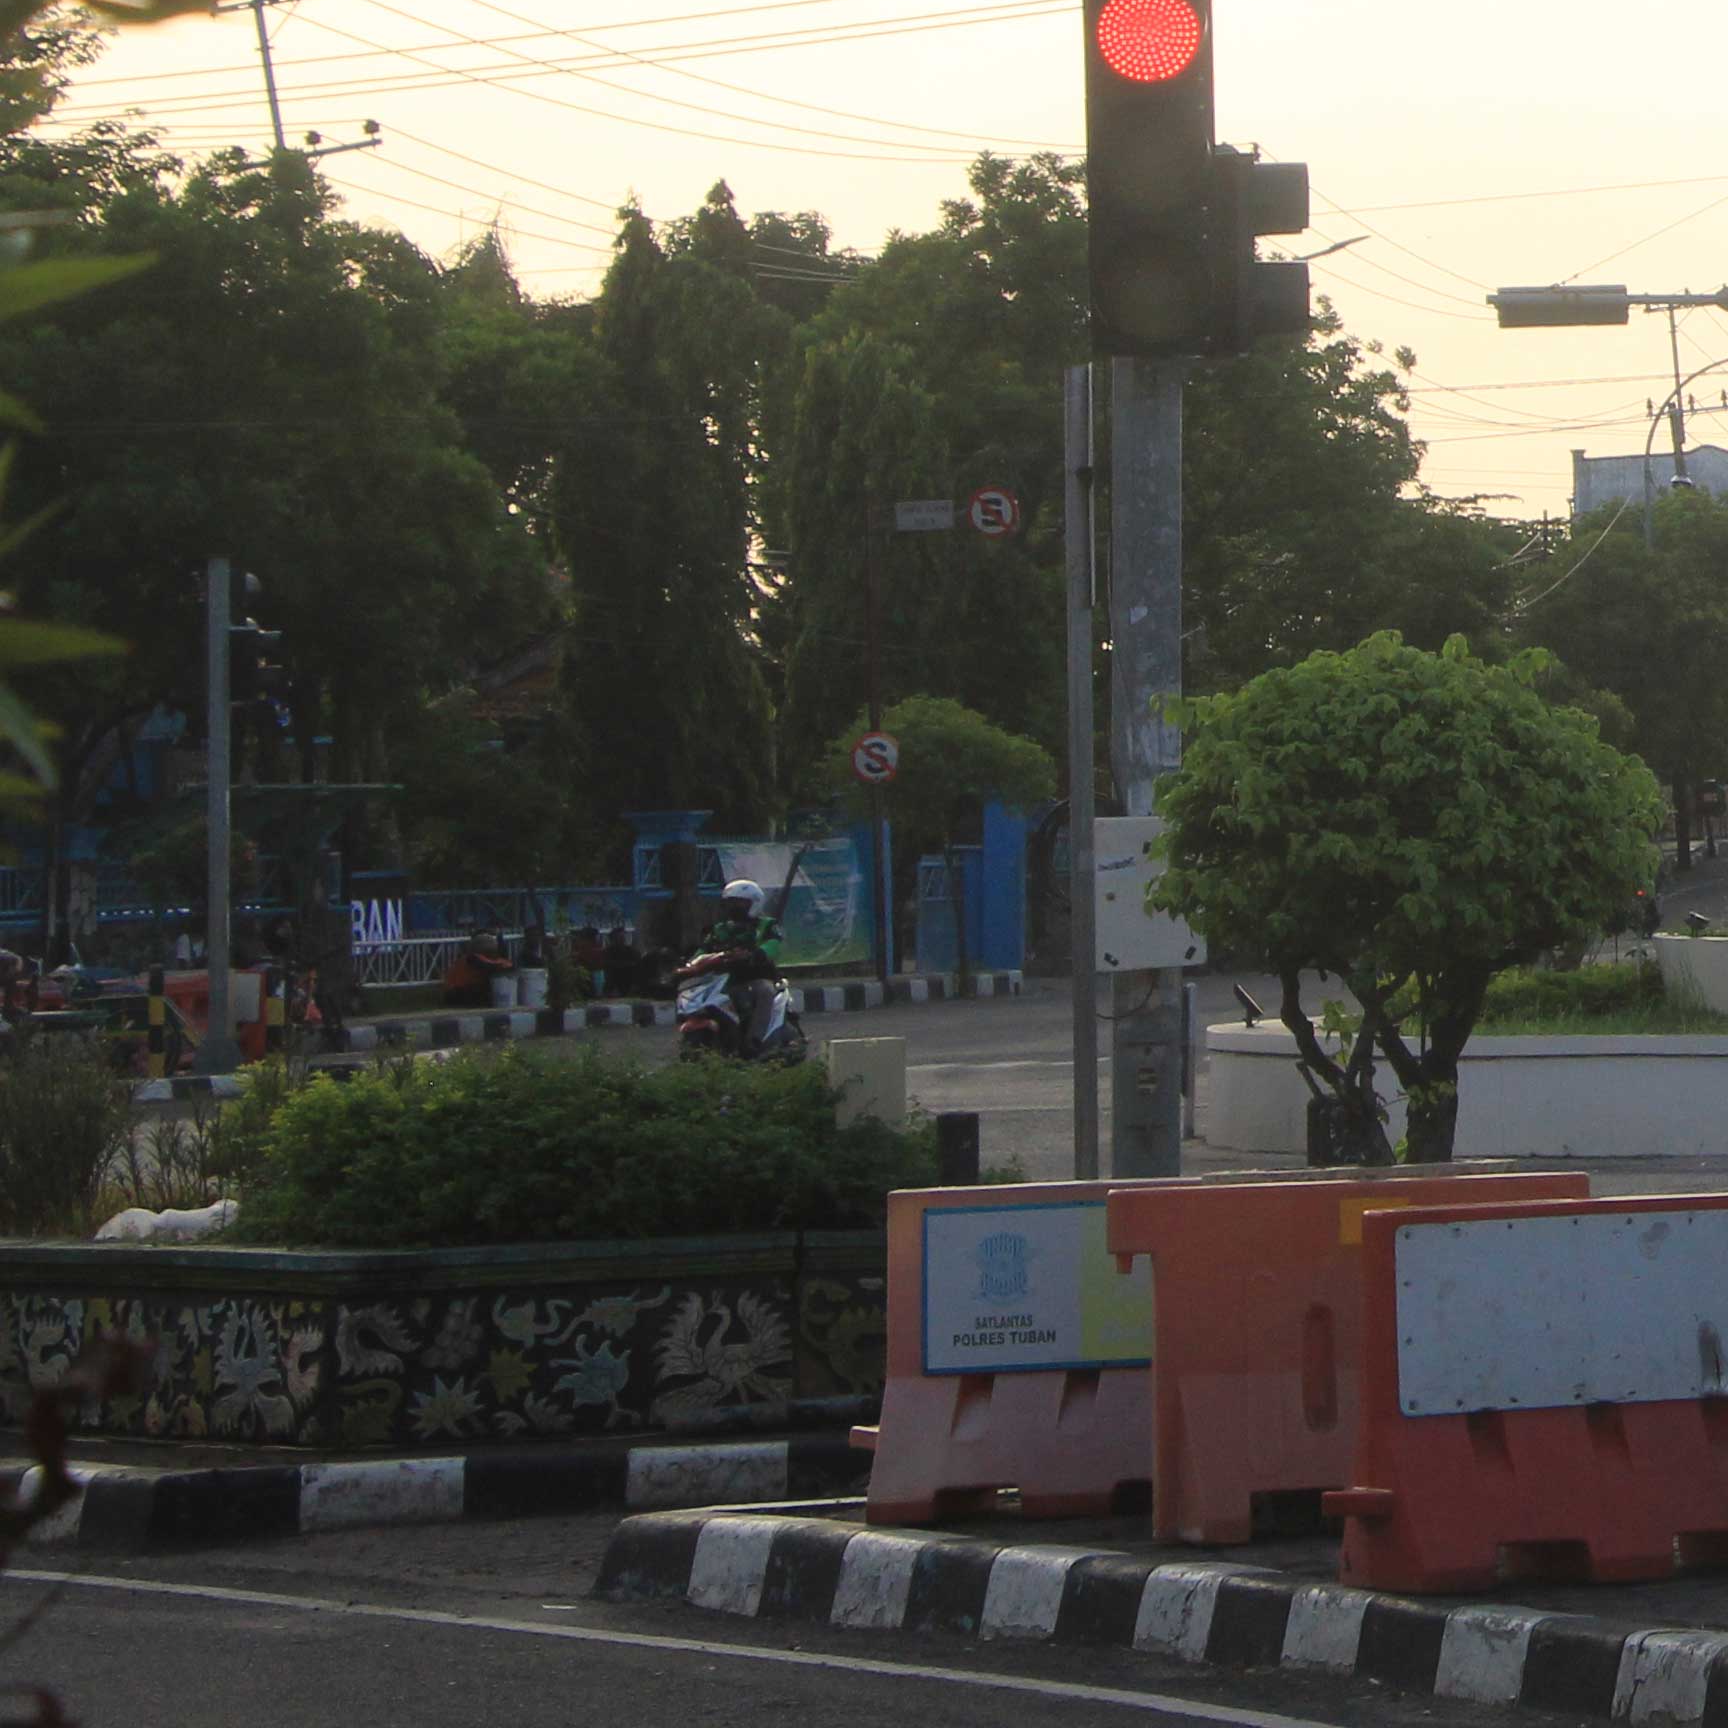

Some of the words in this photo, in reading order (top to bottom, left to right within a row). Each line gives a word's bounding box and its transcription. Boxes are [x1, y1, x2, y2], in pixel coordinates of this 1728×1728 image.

[975, 1314, 1033, 1330] SATLANTAS
[952, 1332, 1006, 1347] POLRES
[1009, 1330, 1057, 1345] TUBAN
